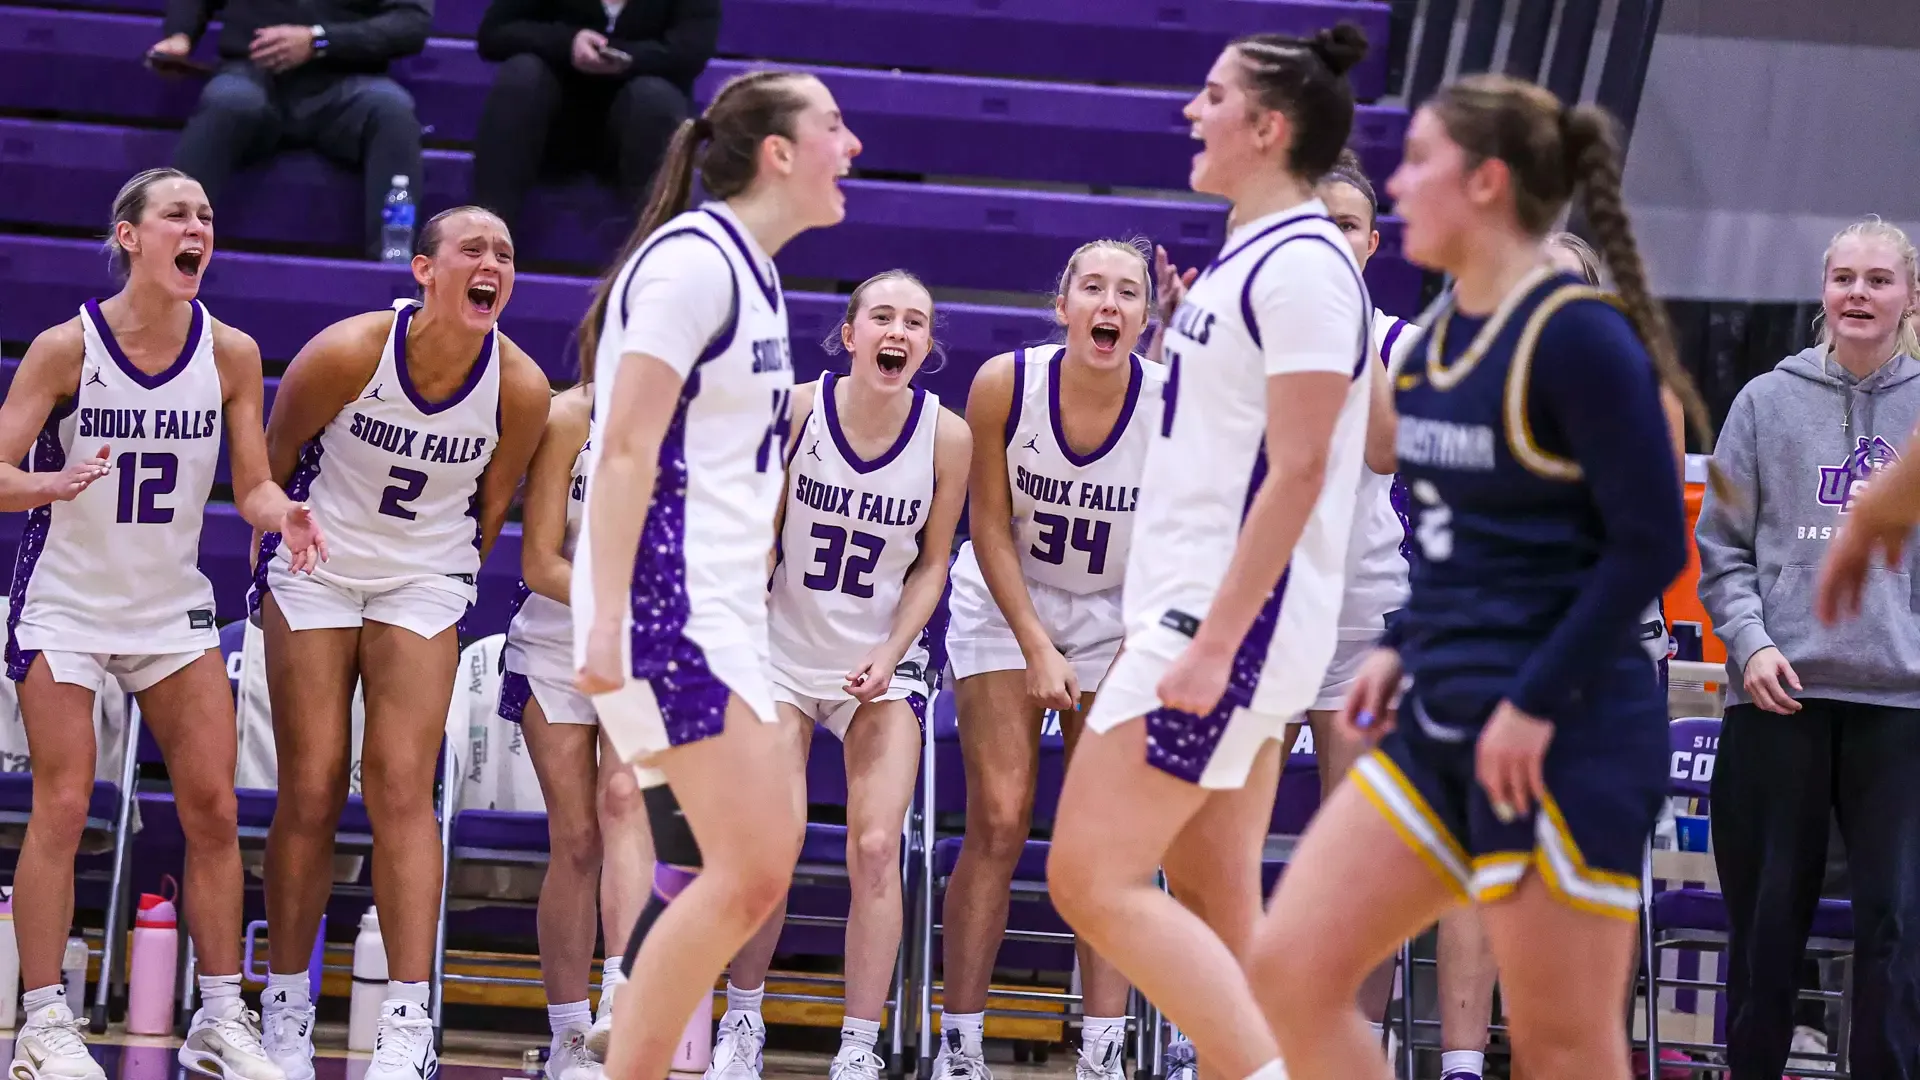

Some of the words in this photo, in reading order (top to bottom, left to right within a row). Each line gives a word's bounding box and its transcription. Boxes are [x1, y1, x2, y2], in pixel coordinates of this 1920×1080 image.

[80, 408, 147, 439] SIOUX
[154, 410, 217, 440] FALLS
[349, 412, 418, 458] SIOUX
[420, 433, 486, 464] FALLS
[116, 452, 179, 524] 12
[378, 465, 429, 521] 2
[796, 473, 855, 518] SIOUX
[857, 492, 922, 526] FALLS
[1016, 464, 1074, 507] SIOUX
[1079, 482, 1140, 512] FALLS
[803, 522, 887, 599] 32
[1030, 510, 1112, 575] 34
[468, 740, 482, 784] Avera
